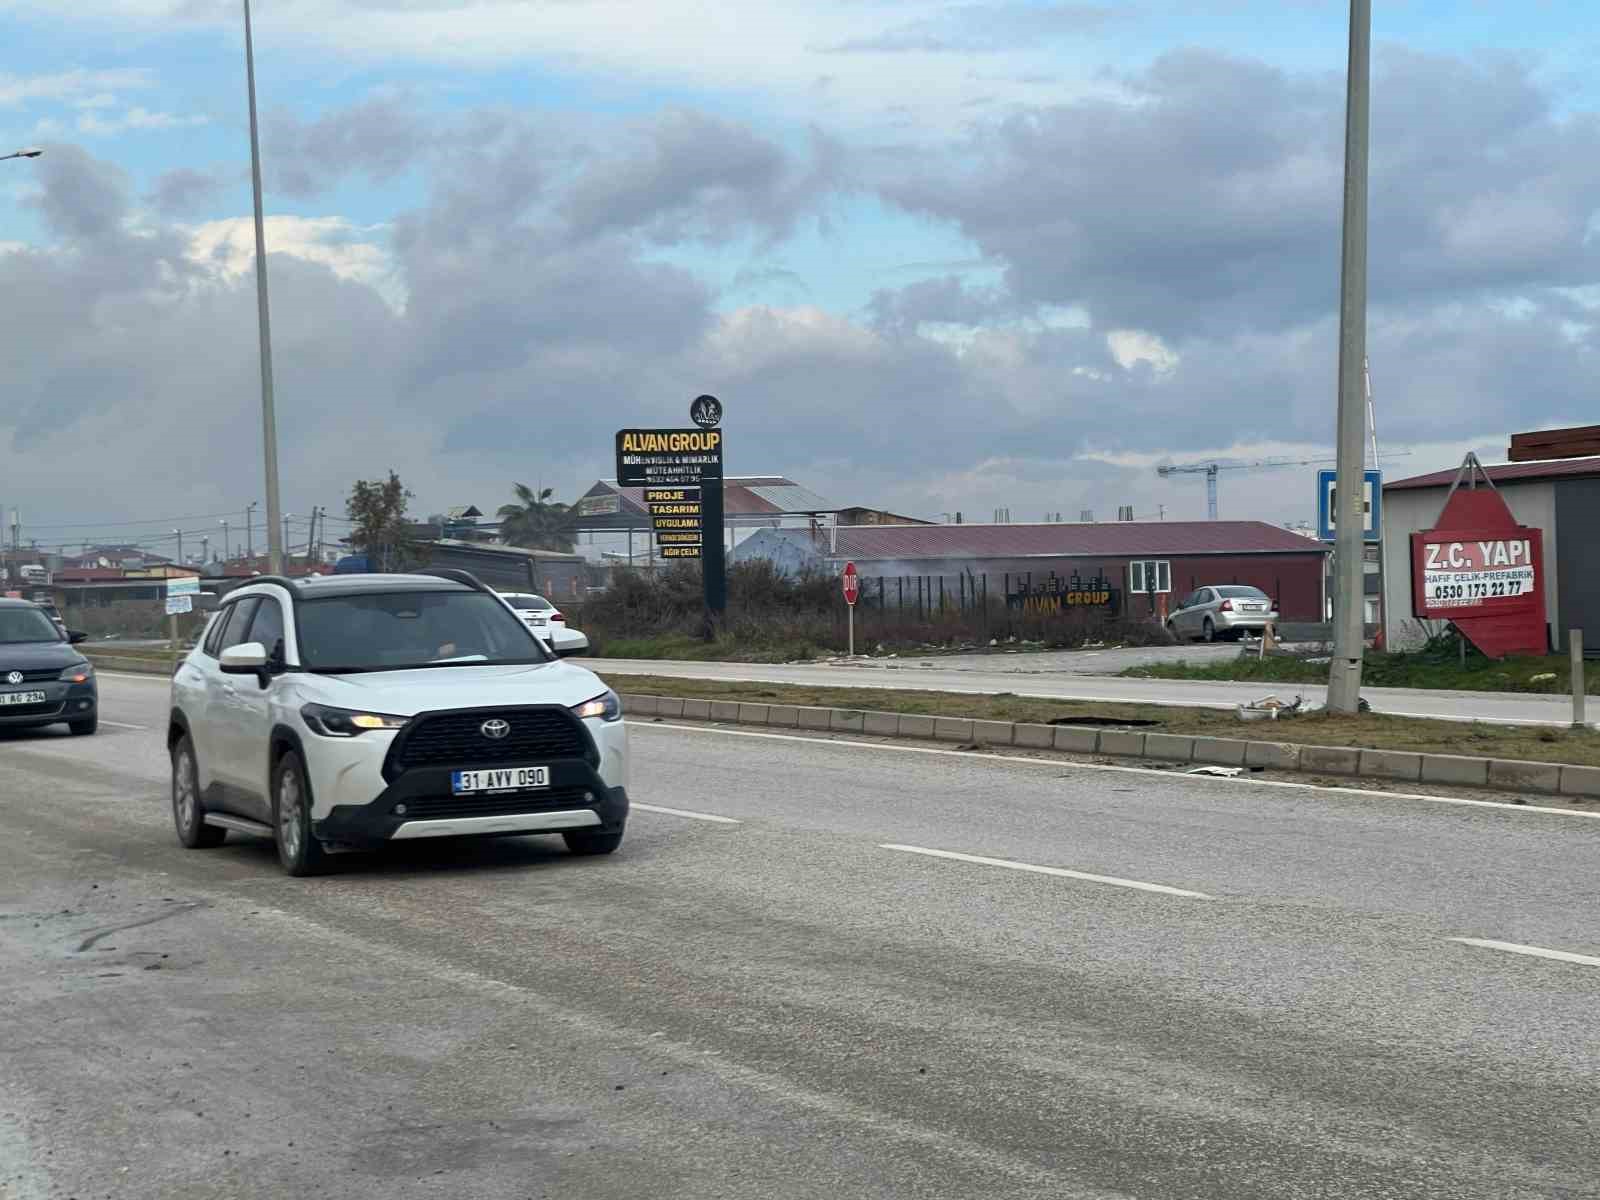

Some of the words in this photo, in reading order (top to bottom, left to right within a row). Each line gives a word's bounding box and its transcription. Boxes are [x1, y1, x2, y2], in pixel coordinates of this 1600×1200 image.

[623, 433, 668, 451] ALVAN
[669, 432, 720, 451] GROUP
[648, 491, 685, 500] PROJE
[652, 505, 699, 514] TASARIM
[656, 519, 699, 528] UYGULAMA
[1425, 542, 1473, 569] Z.C.
[1478, 540, 1531, 567] YAPI
[1435, 586, 1463, 599] 0530
[1468, 583, 1487, 598] 173
[1491, 582, 1505, 596] 22
[1508, 580, 1522, 594] 77
[1066, 592, 1109, 604] GROUP
[463, 773, 479, 790] 31
[519, 768, 545, 786] 090
